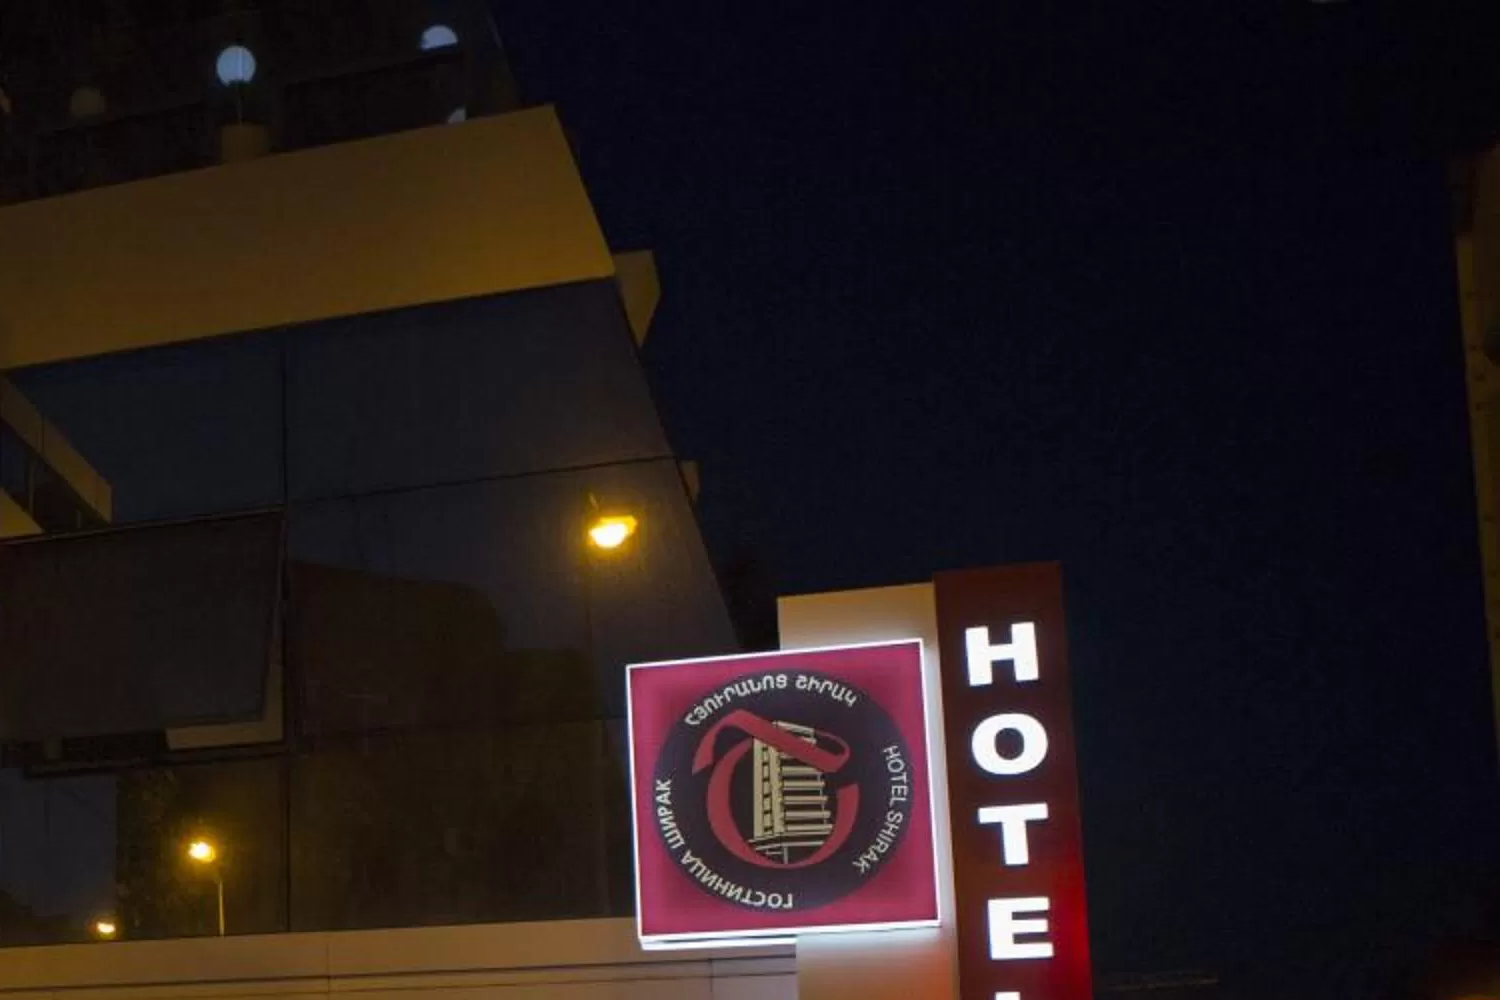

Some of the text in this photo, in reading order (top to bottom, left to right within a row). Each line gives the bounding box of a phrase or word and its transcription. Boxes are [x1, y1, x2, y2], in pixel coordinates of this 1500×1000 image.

[795, 674, 858, 708] ՇԻՐԱԿ
[655, 779, 793, 909] ГОСТИНИЦА ШИРАК
[852, 744, 909, 874] HOTEL SHIRAK
